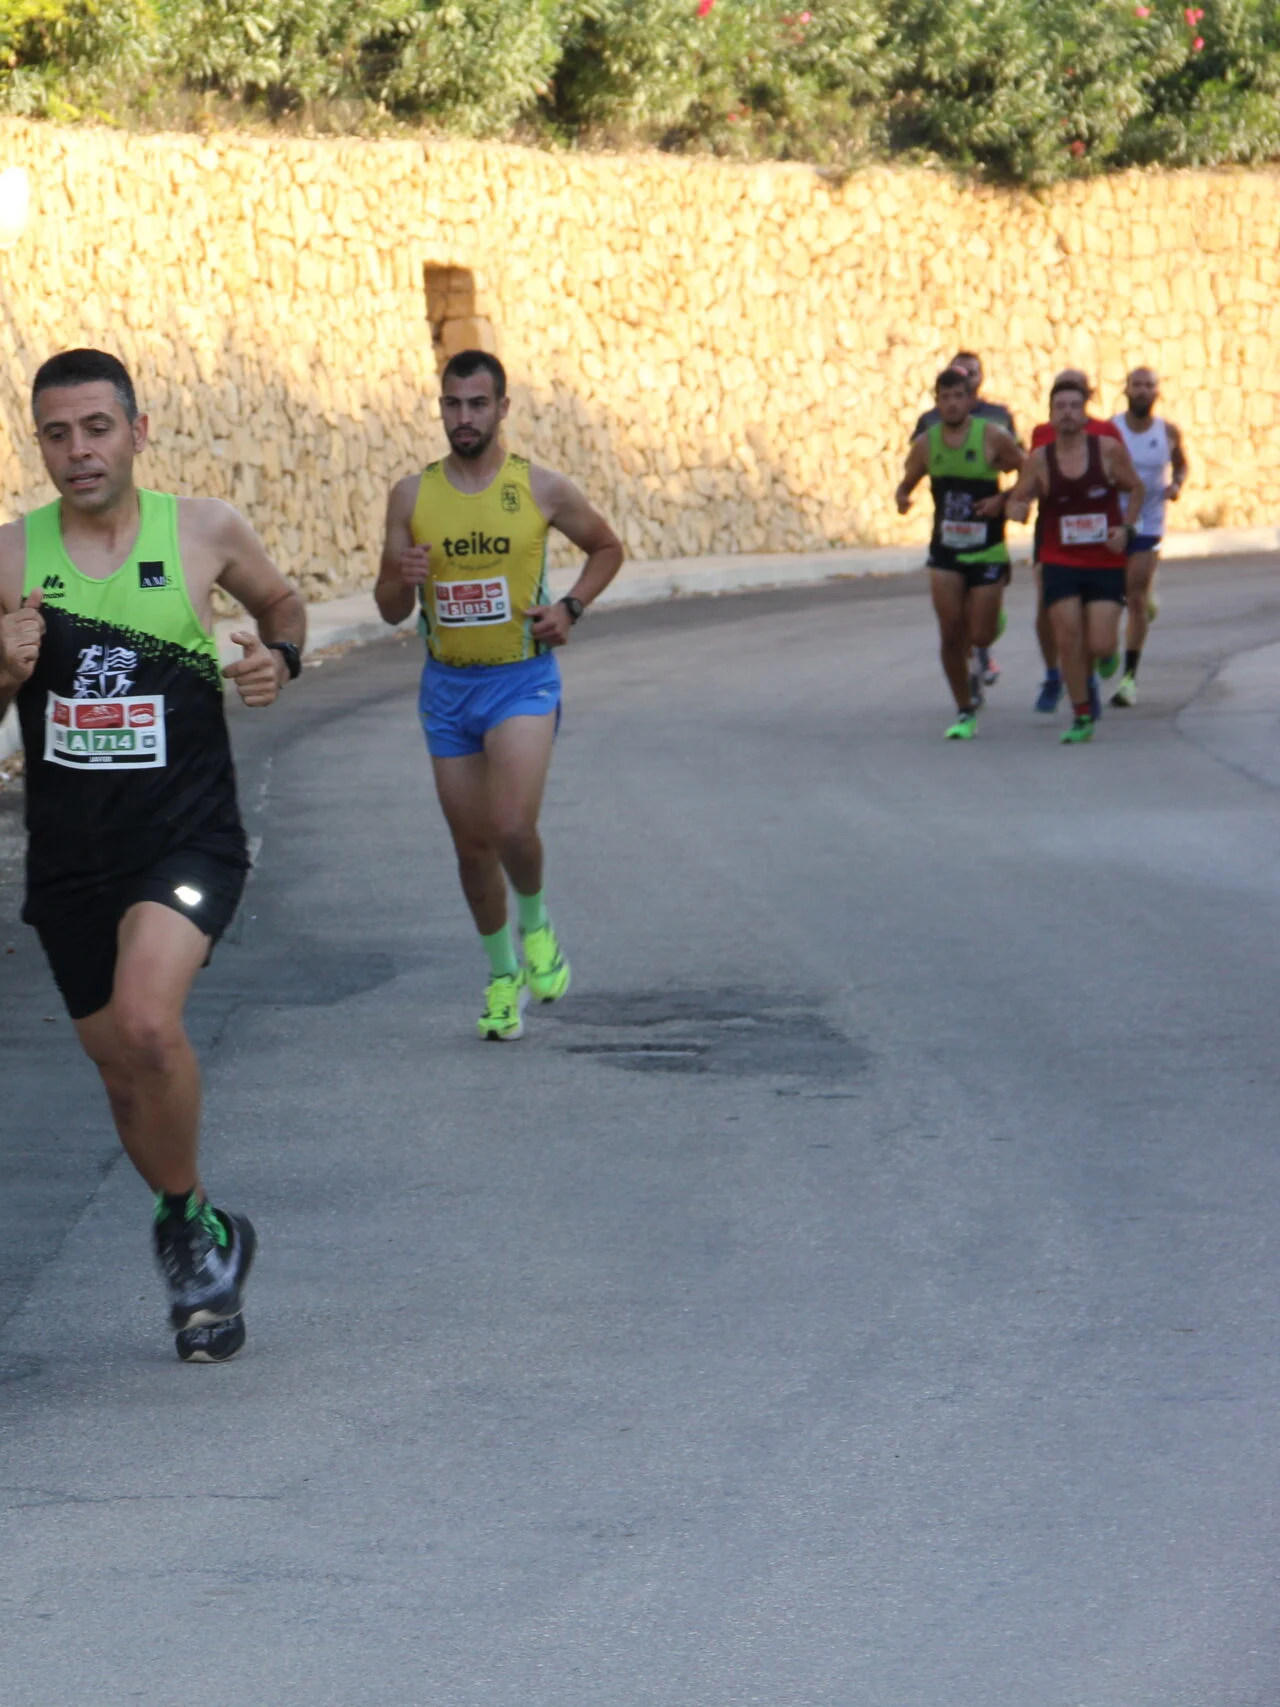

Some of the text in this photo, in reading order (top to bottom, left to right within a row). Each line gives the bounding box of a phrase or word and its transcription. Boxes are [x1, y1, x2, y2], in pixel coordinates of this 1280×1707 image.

[443, 532, 510, 557] teika
[450, 604, 459, 615] S
[71, 735, 87, 750] A
[94, 735, 132, 750] 714
